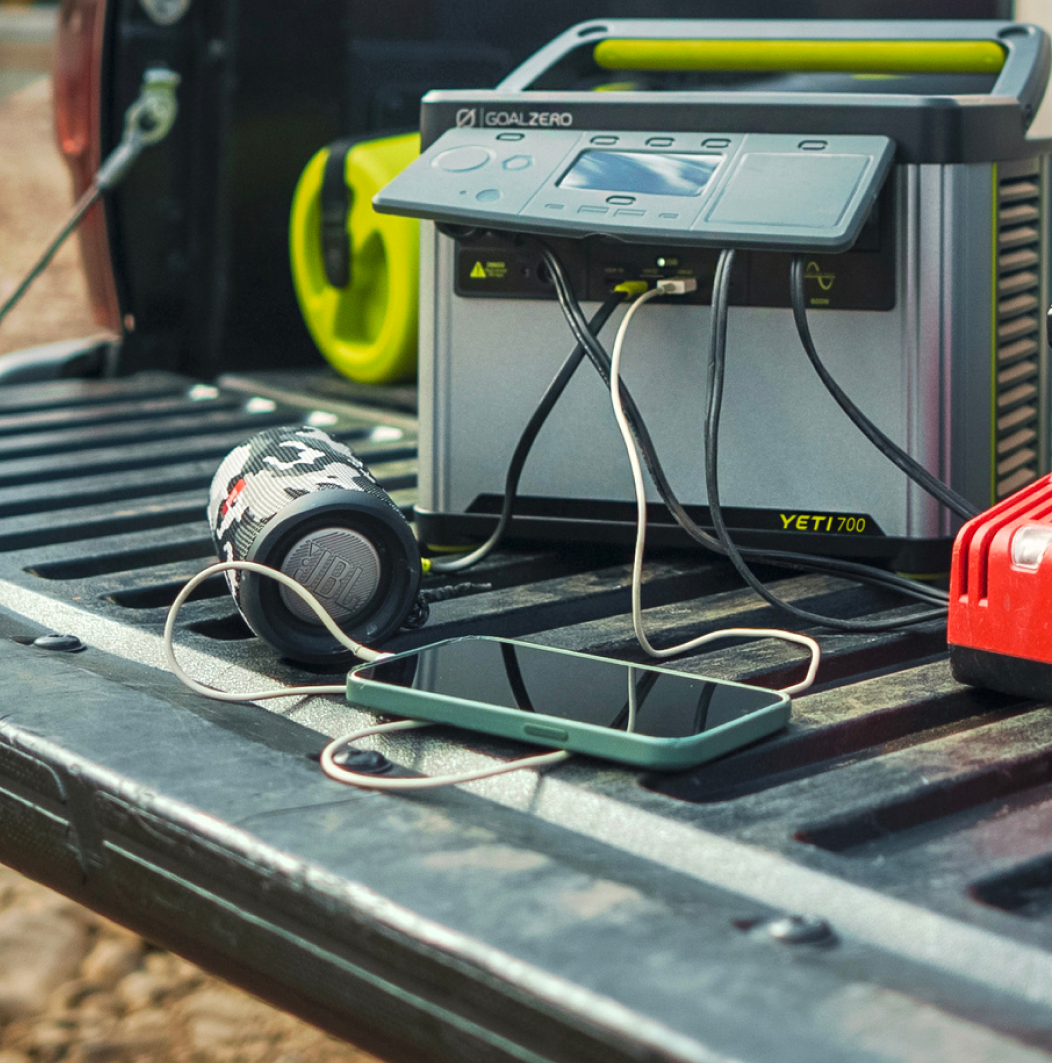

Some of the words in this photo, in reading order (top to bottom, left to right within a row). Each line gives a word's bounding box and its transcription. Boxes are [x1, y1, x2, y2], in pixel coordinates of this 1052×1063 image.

[779, 513, 834, 532] YETI
[836, 516, 867, 533] 700
[293, 548, 364, 612] JBL
